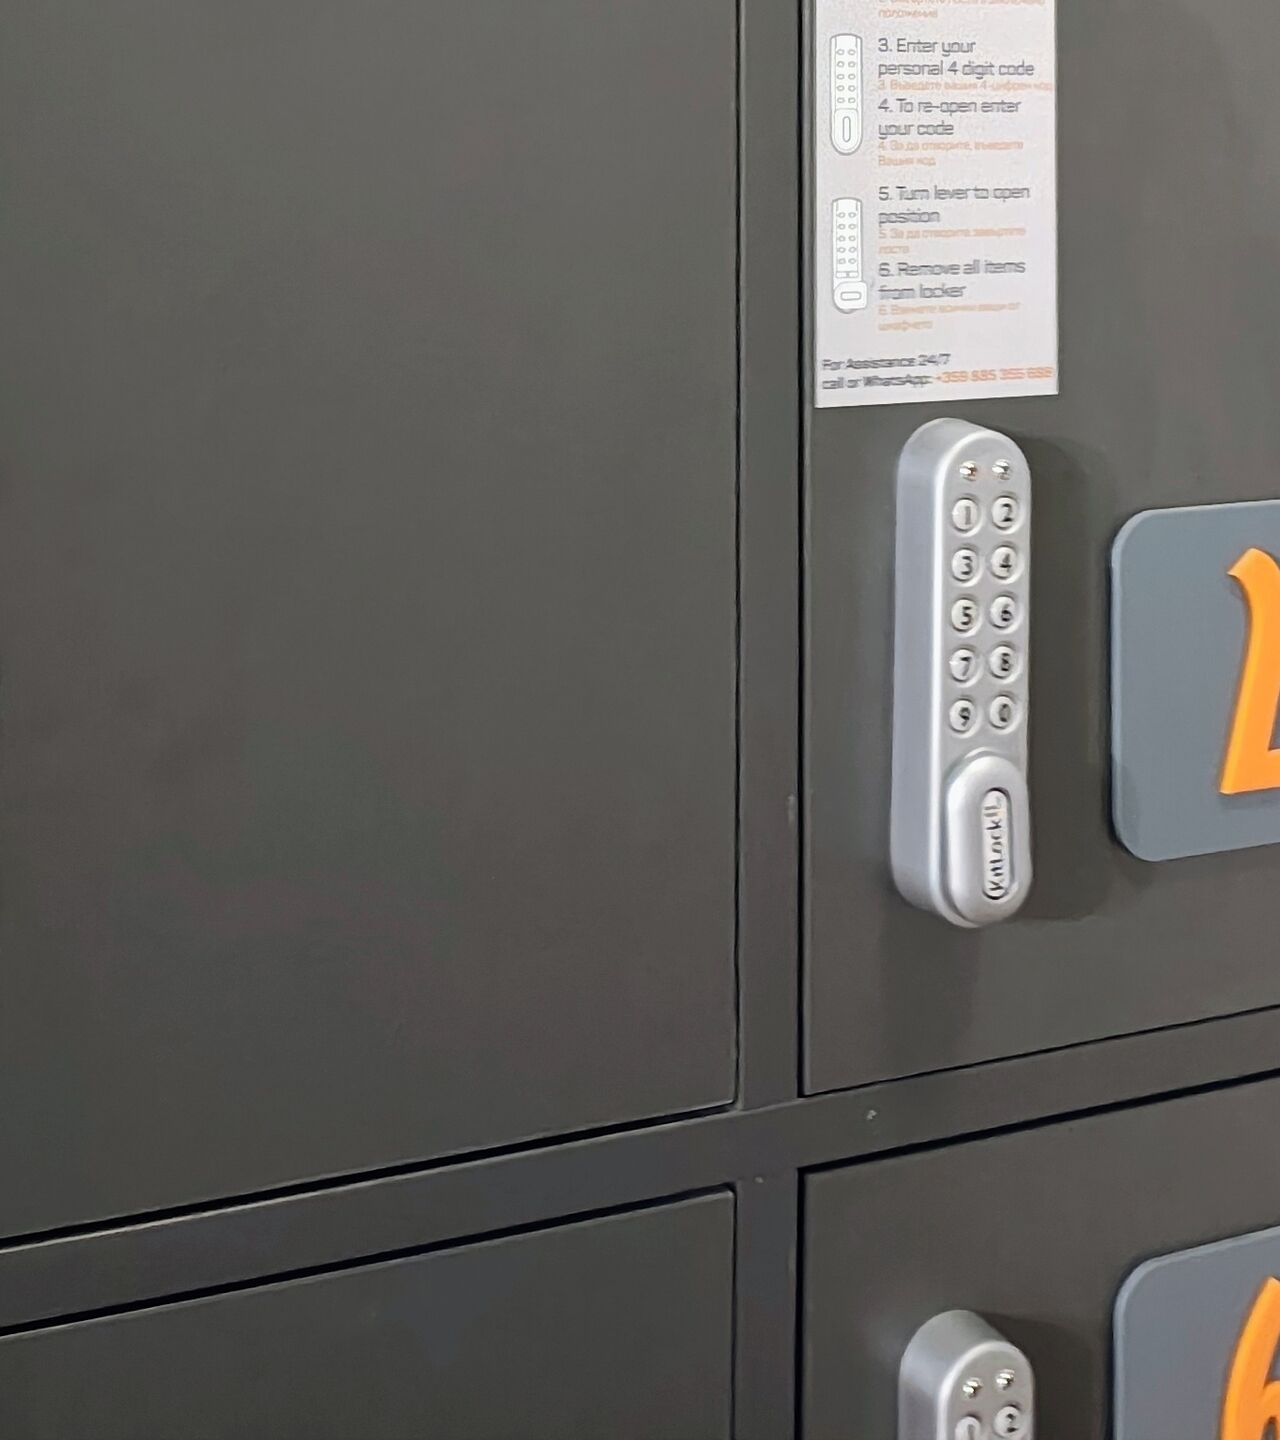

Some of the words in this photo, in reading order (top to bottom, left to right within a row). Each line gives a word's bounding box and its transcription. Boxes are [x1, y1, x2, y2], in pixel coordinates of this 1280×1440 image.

[878, 37, 893, 52] 3.
[896, 37, 938, 53] Enter
[941, 41, 976, 57] your
[878, 60, 944, 78] personal
[947, 60, 959, 76] 4
[962, 60, 995, 80] digit
[998, 59, 1035, 76] code
[877, 98, 893, 113] 4.
[896, 98, 914, 113] To
[917, 101, 977, 117] re-open
[980, 99, 1022, 113] enter
[878, 124, 915, 140] your
[917, 119, 955, 136] code
[878, 185, 893, 201] 5.
[895, 185, 930, 201] Turn
[933, 184, 970, 200] lever
[972, 185, 989, 200] to
[993, 187, 1030, 203] open
[878, 208, 940, 228] position
